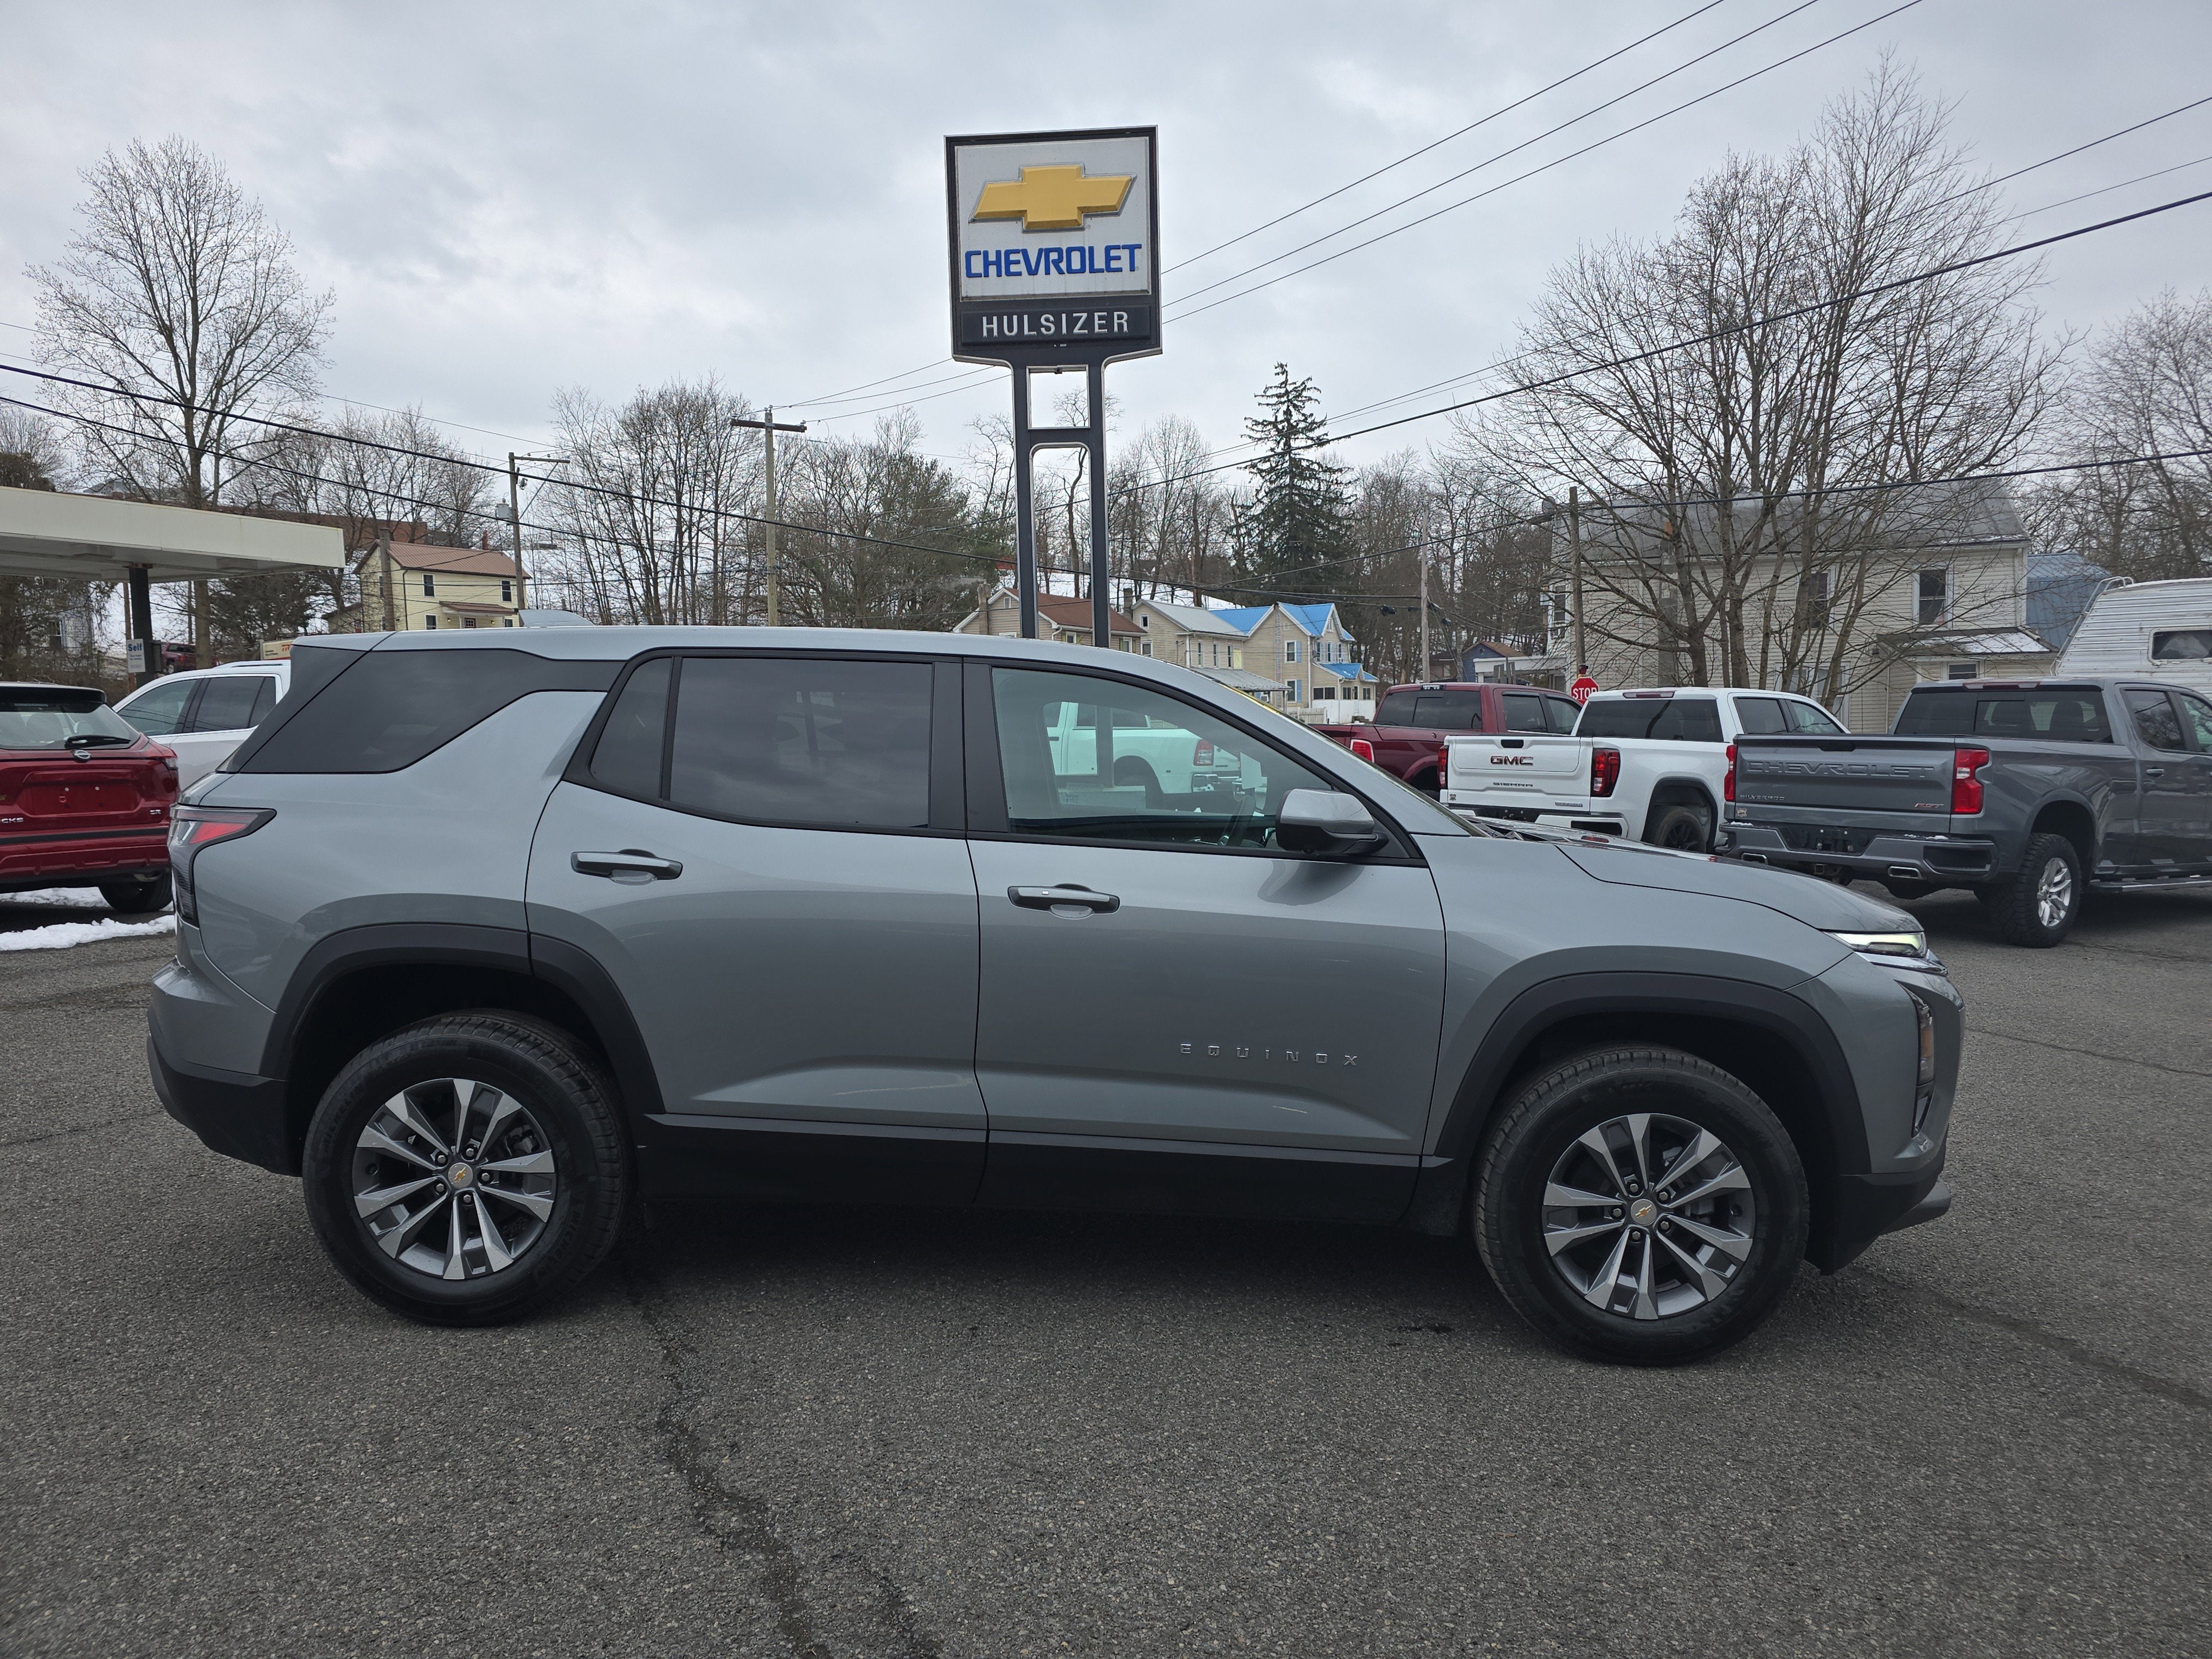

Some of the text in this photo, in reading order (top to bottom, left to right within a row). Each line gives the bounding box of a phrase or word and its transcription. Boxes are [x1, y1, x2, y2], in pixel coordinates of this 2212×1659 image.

[964, 243, 1142, 278] CHEVROLET
[982, 311, 1128, 338] HULSIZER
[281, 644, 291, 652] TR
[1490, 755, 1533, 766] GMC
[1747, 761, 1934, 777] CHEVROLET
[1180, 1044, 1358, 1066] EQUINOX
